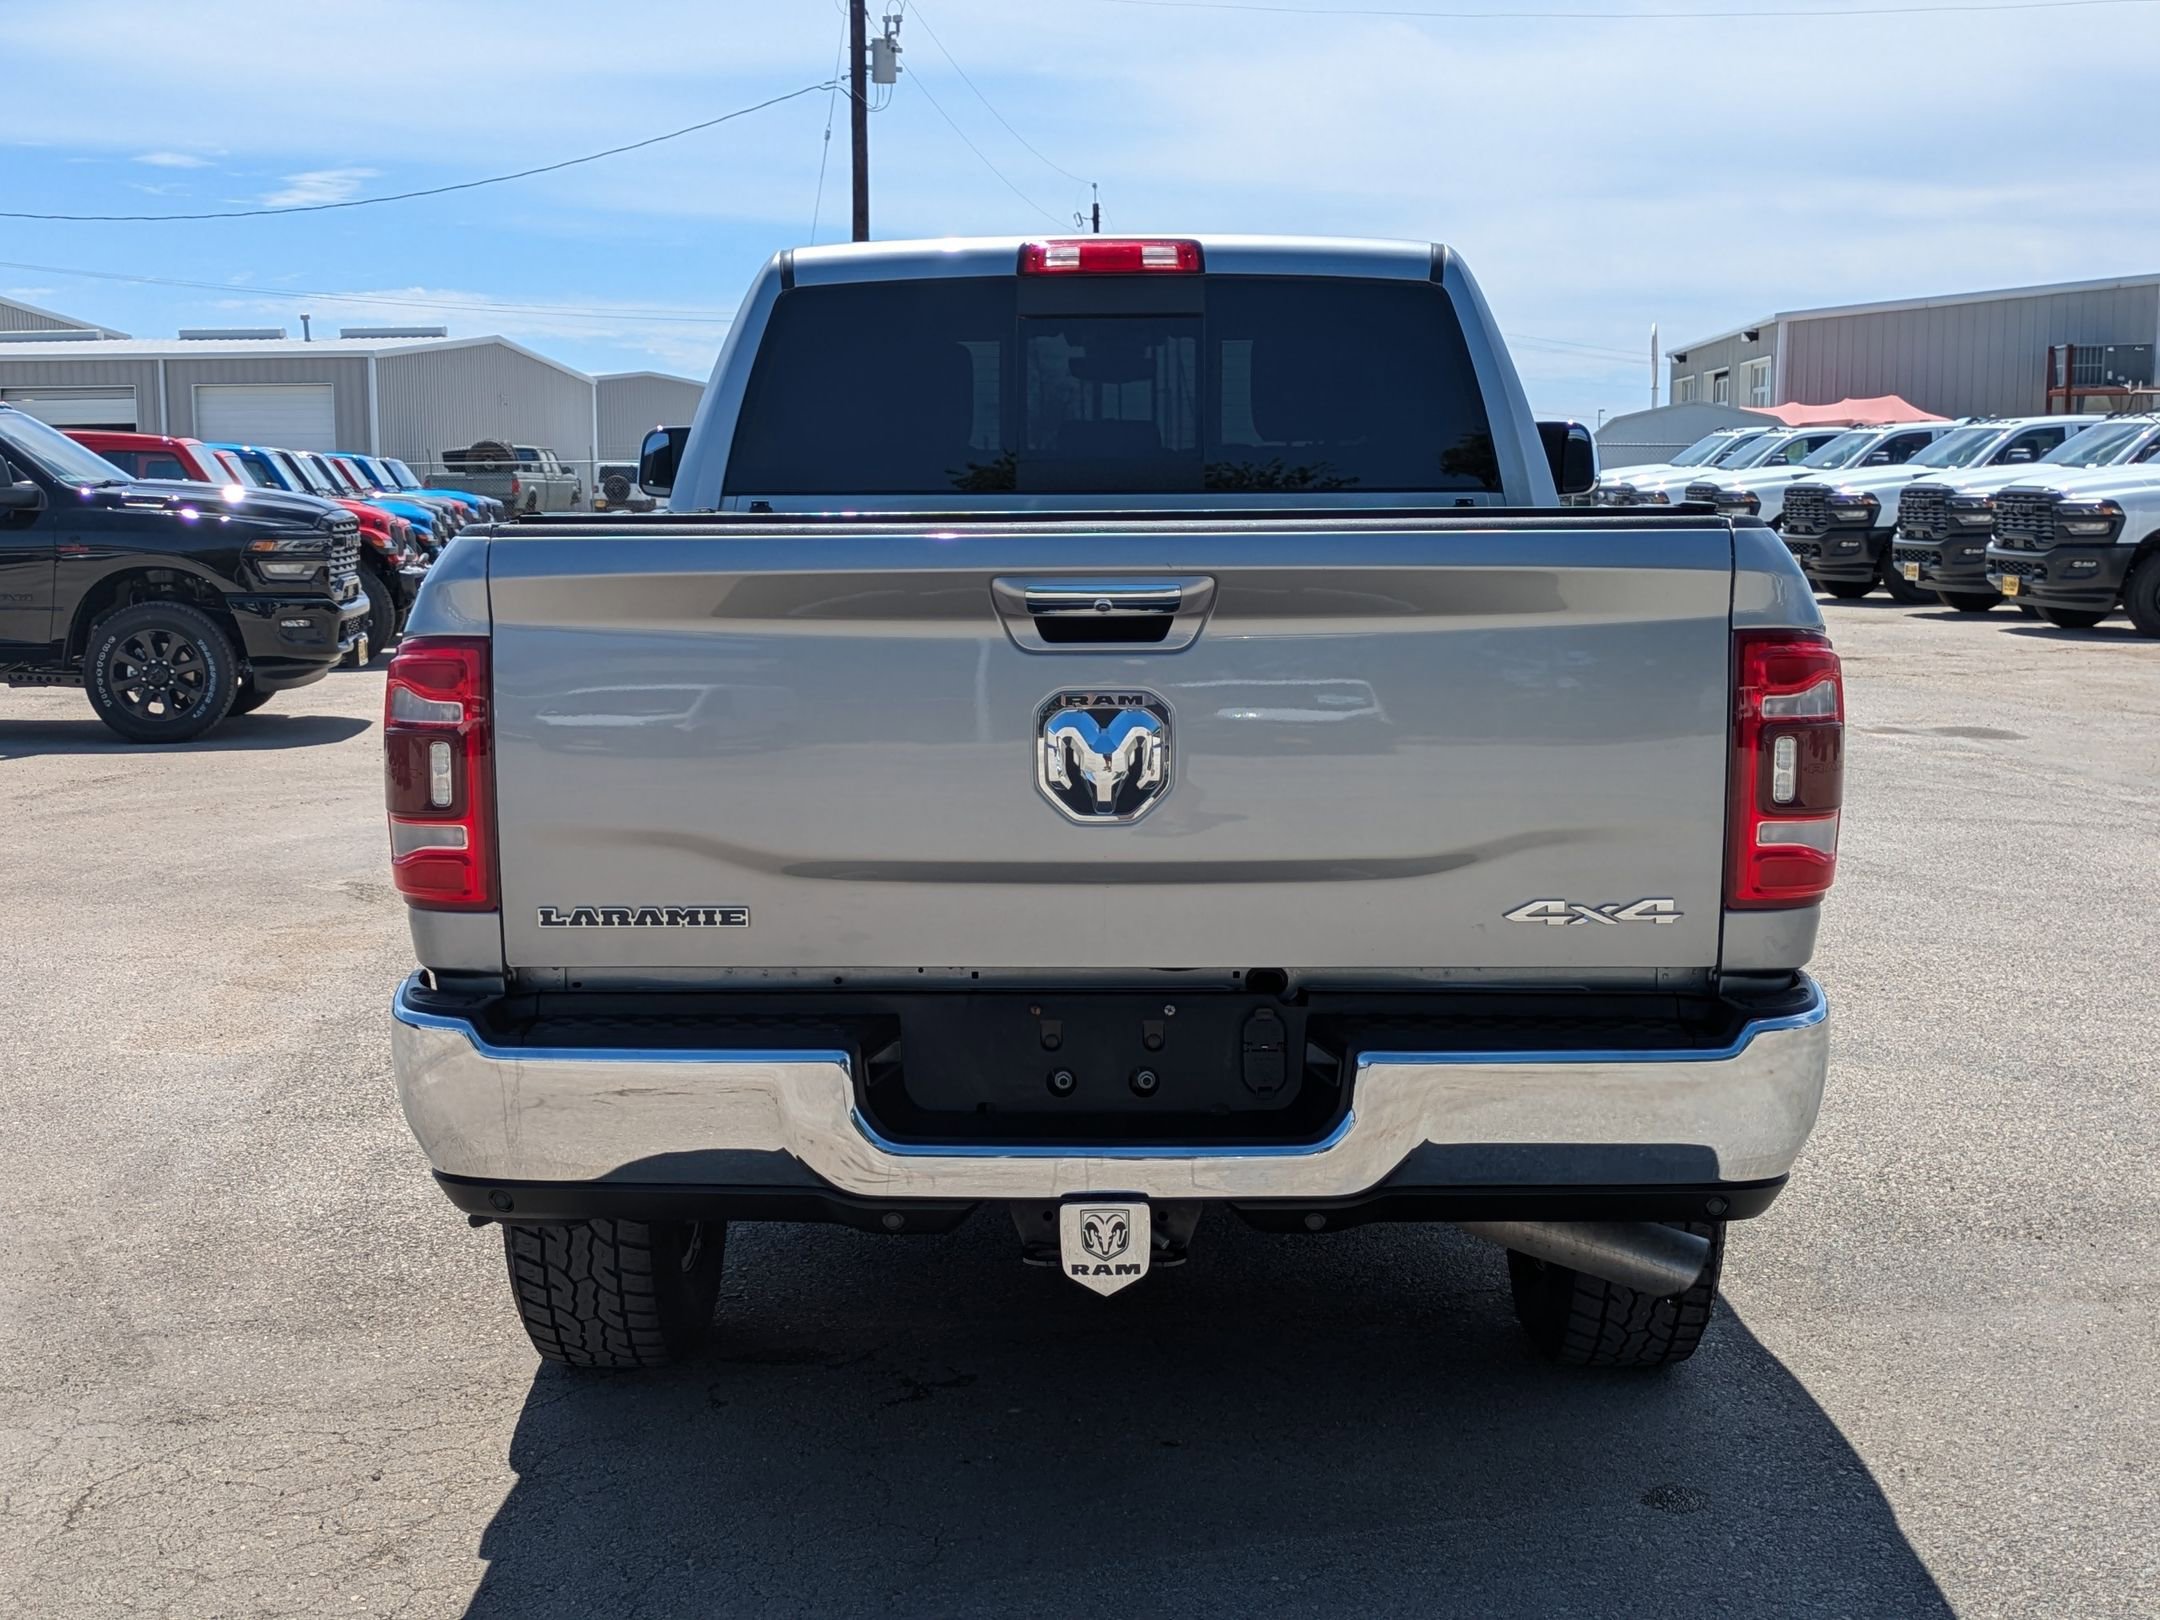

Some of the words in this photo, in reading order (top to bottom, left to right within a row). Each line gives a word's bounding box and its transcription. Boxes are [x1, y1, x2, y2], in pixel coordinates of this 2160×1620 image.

[1065, 694, 1143, 706] RAM
[537, 906, 749, 928] LARAMIE
[1071, 1263, 1141, 1276] RAM
